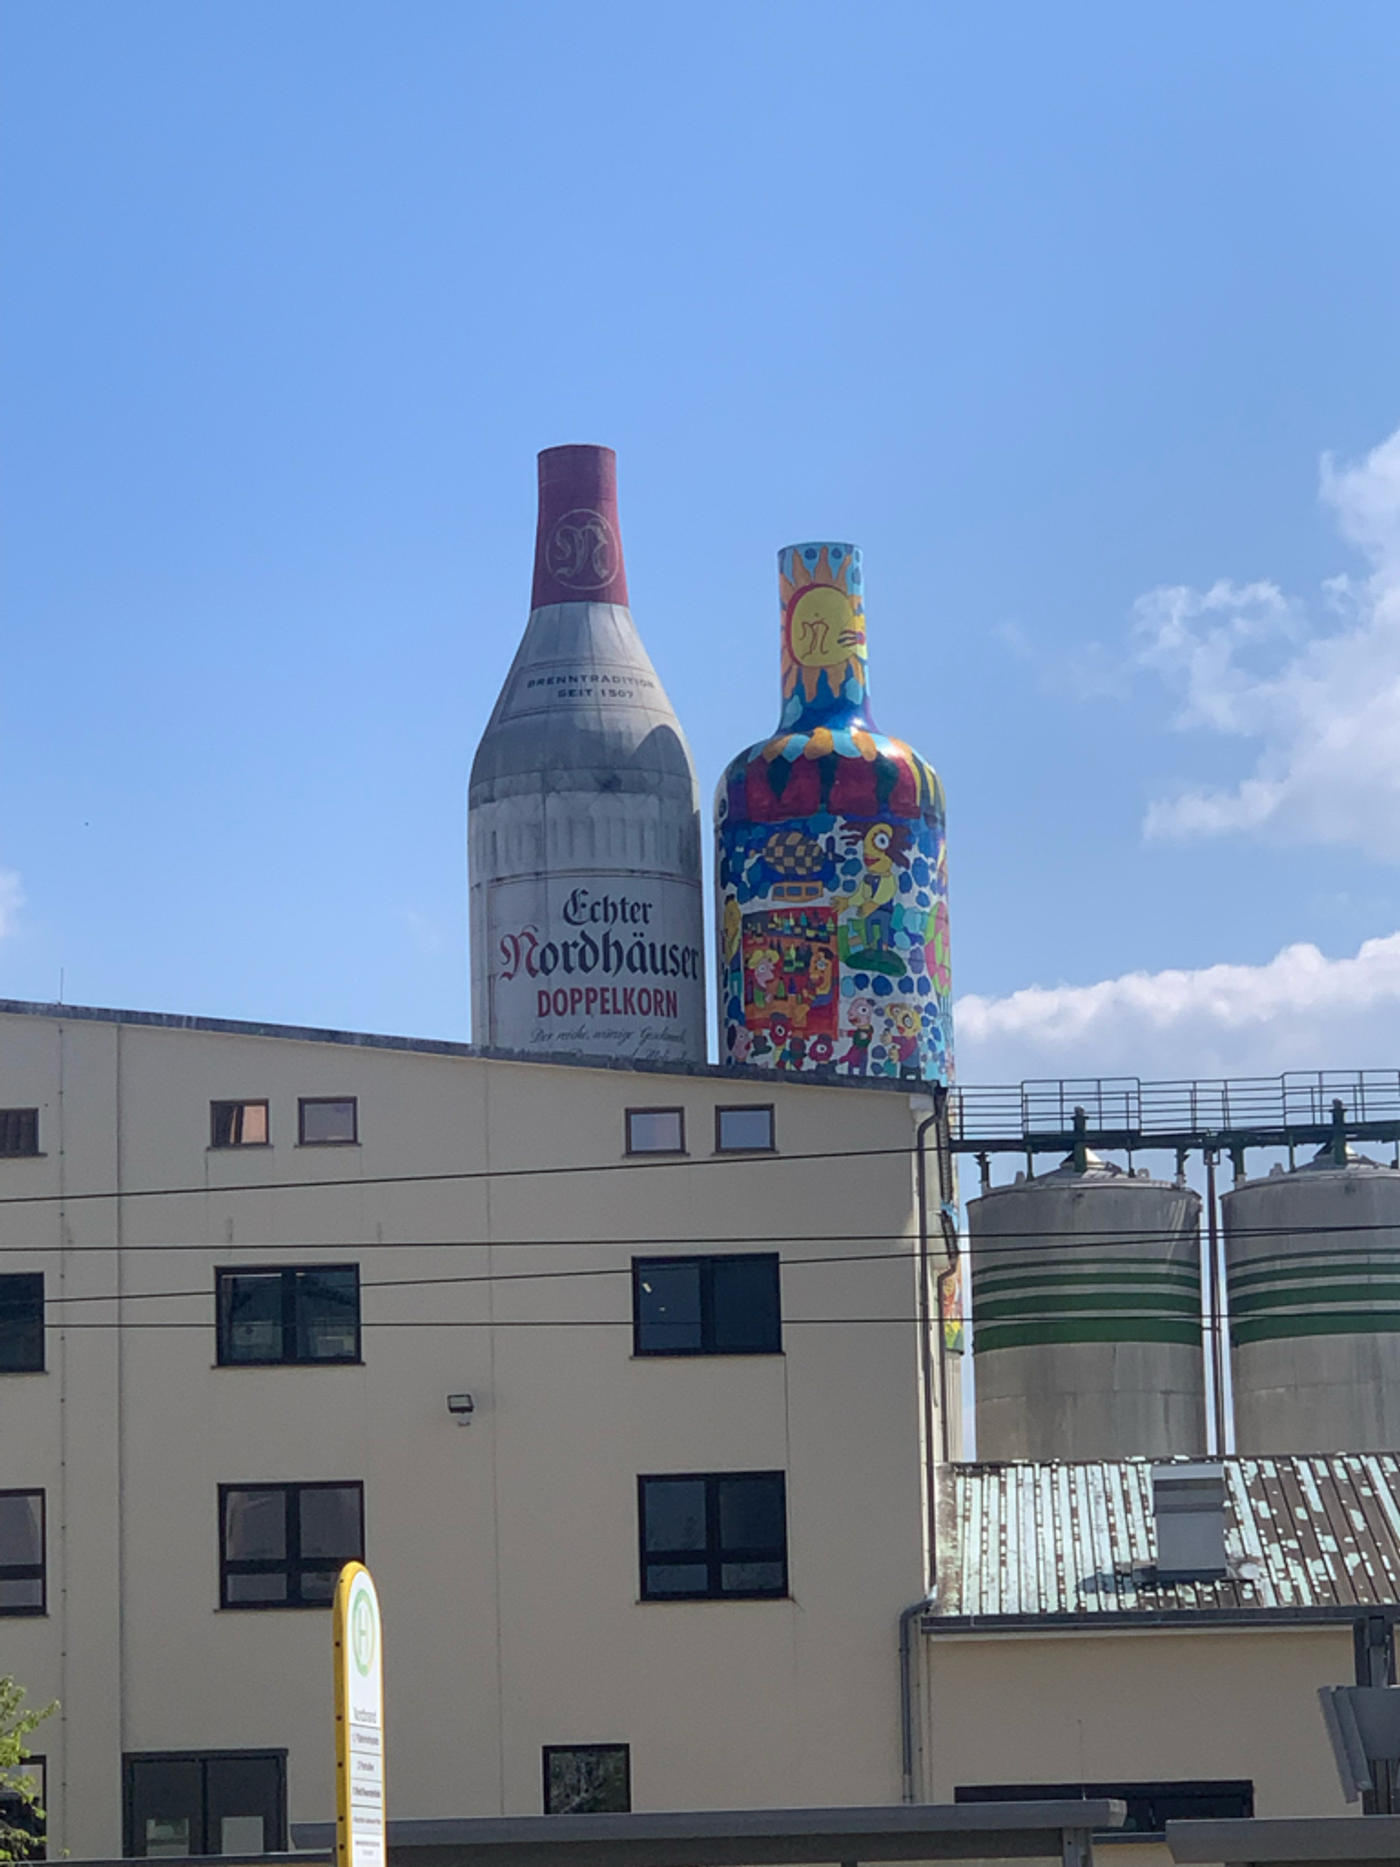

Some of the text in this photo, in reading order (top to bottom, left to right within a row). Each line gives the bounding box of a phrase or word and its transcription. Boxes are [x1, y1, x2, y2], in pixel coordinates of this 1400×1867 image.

[526, 674, 656, 689] BRENNTRADITION
[557, 688, 634, 699] SEIT 1507
[562, 888, 653, 926] Echter
[499, 924, 699, 981] Nordhäuser
[537, 987, 679, 1019] DOPPELKORN
